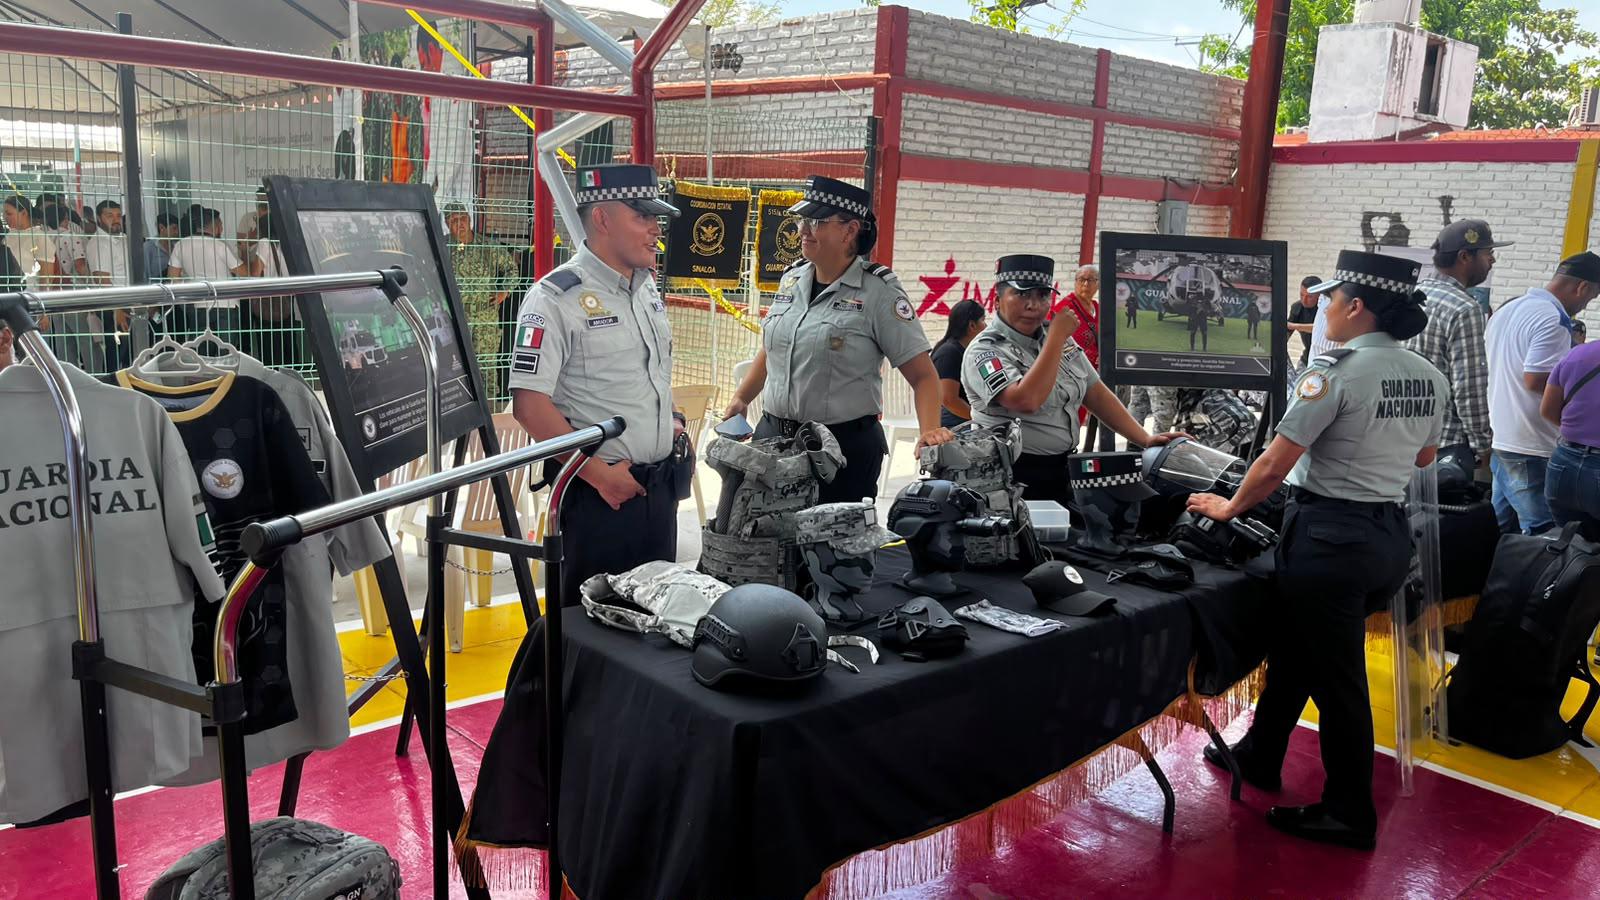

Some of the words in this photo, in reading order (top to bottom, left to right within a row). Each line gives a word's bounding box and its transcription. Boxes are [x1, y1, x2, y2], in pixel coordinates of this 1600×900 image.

[692, 265, 716, 273] SINALOA
[1381, 379, 1435, 398] GUARDIA
[1376, 399, 1436, 418] NACIONAL
[347, 888, 361, 900] GN
